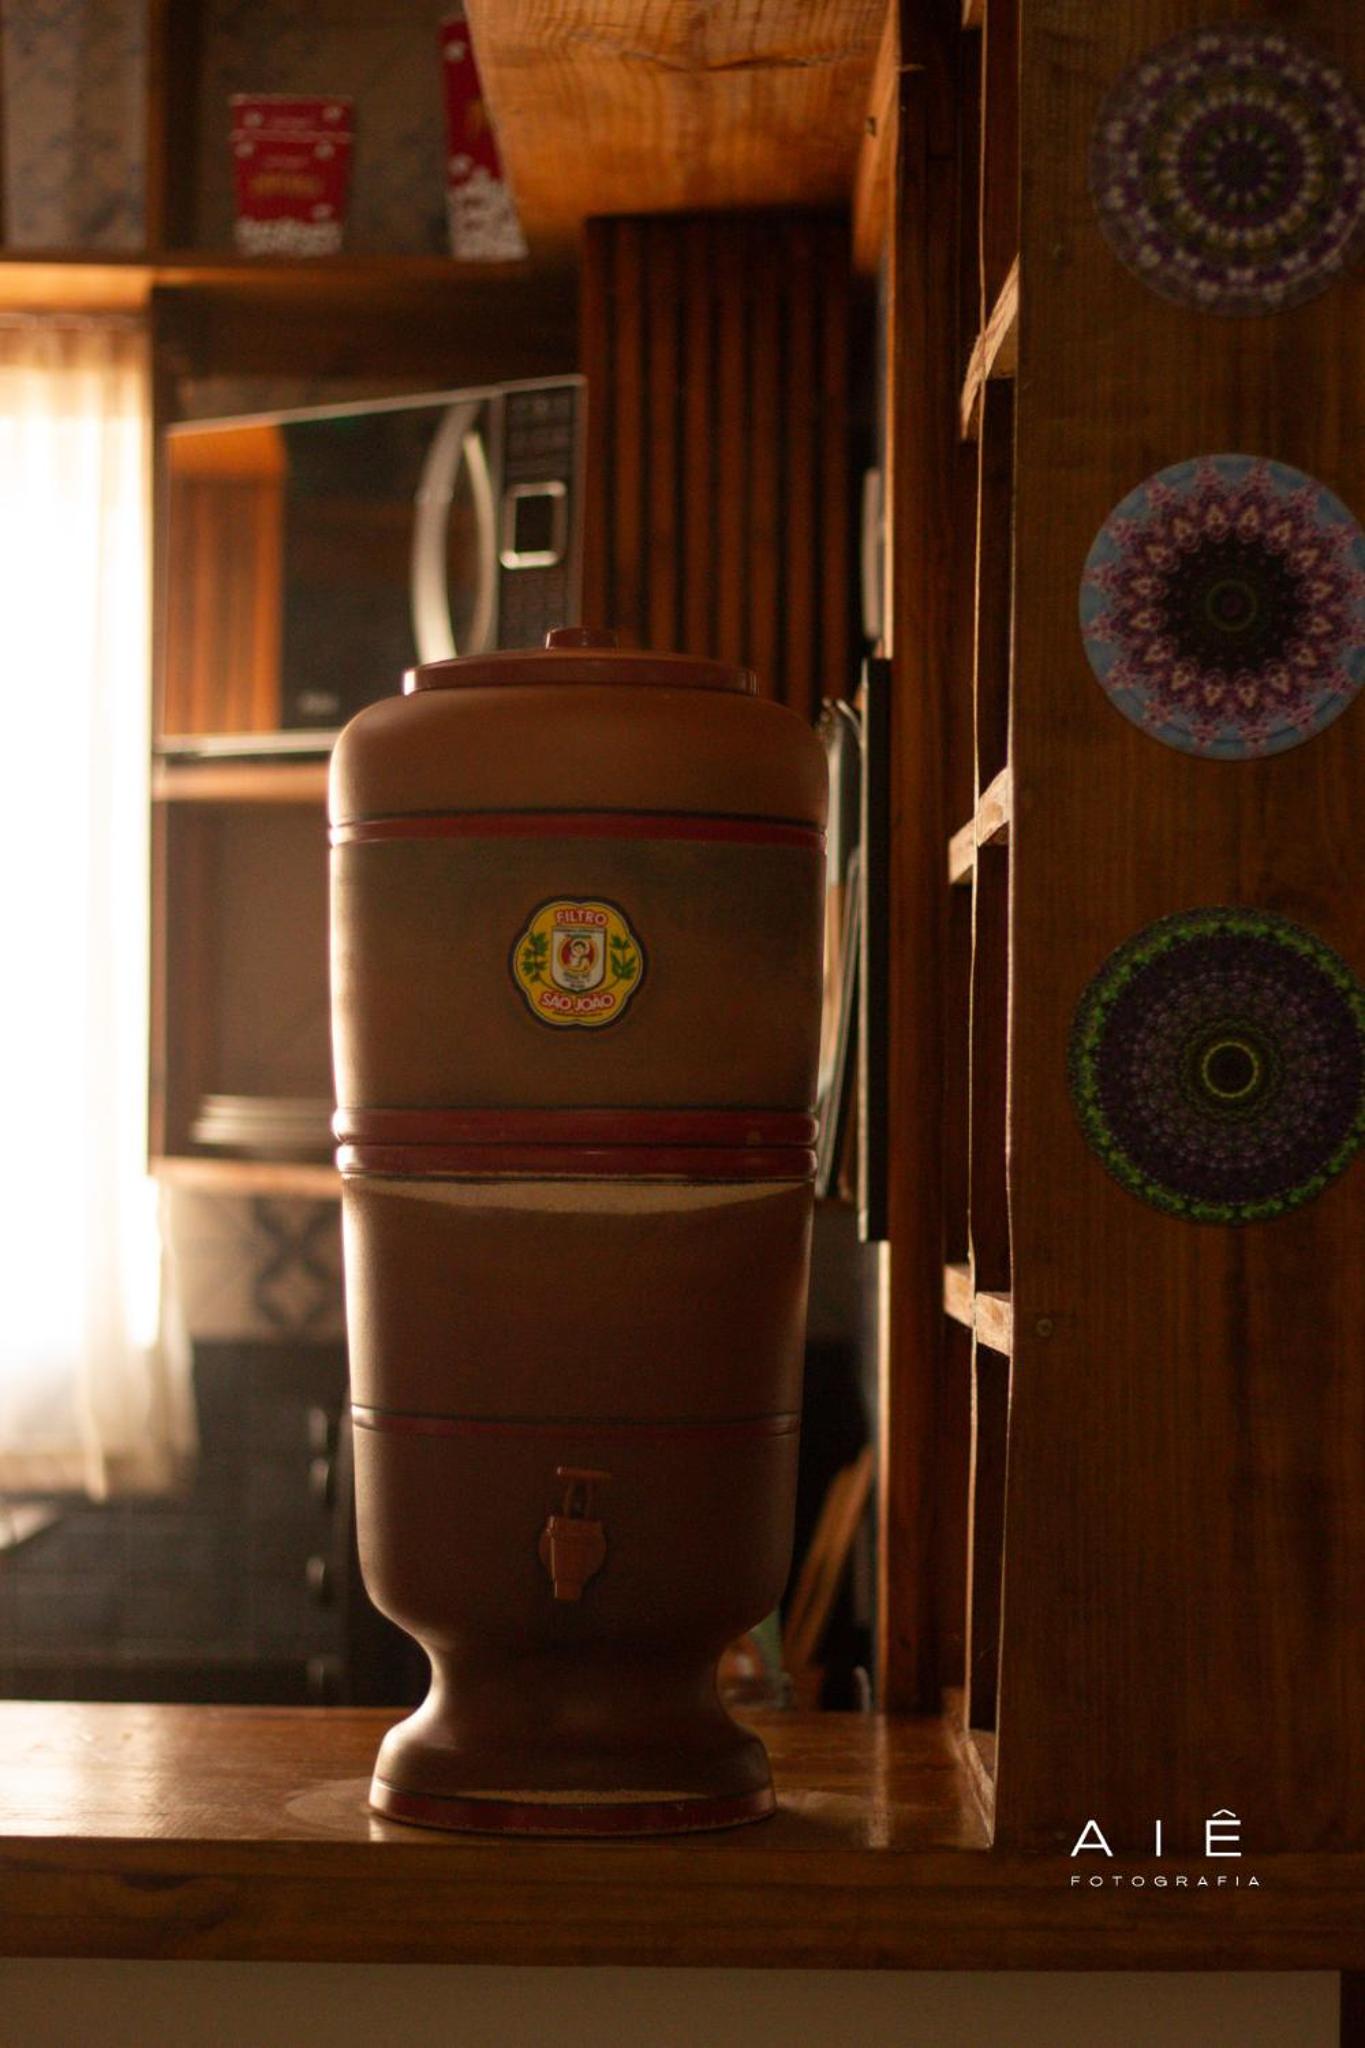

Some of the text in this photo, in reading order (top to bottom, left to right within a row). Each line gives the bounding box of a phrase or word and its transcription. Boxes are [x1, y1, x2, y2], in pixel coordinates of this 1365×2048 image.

[556, 910, 608, 926] FILTRO
[541, 991, 615, 1011] SÃO JOÃO
